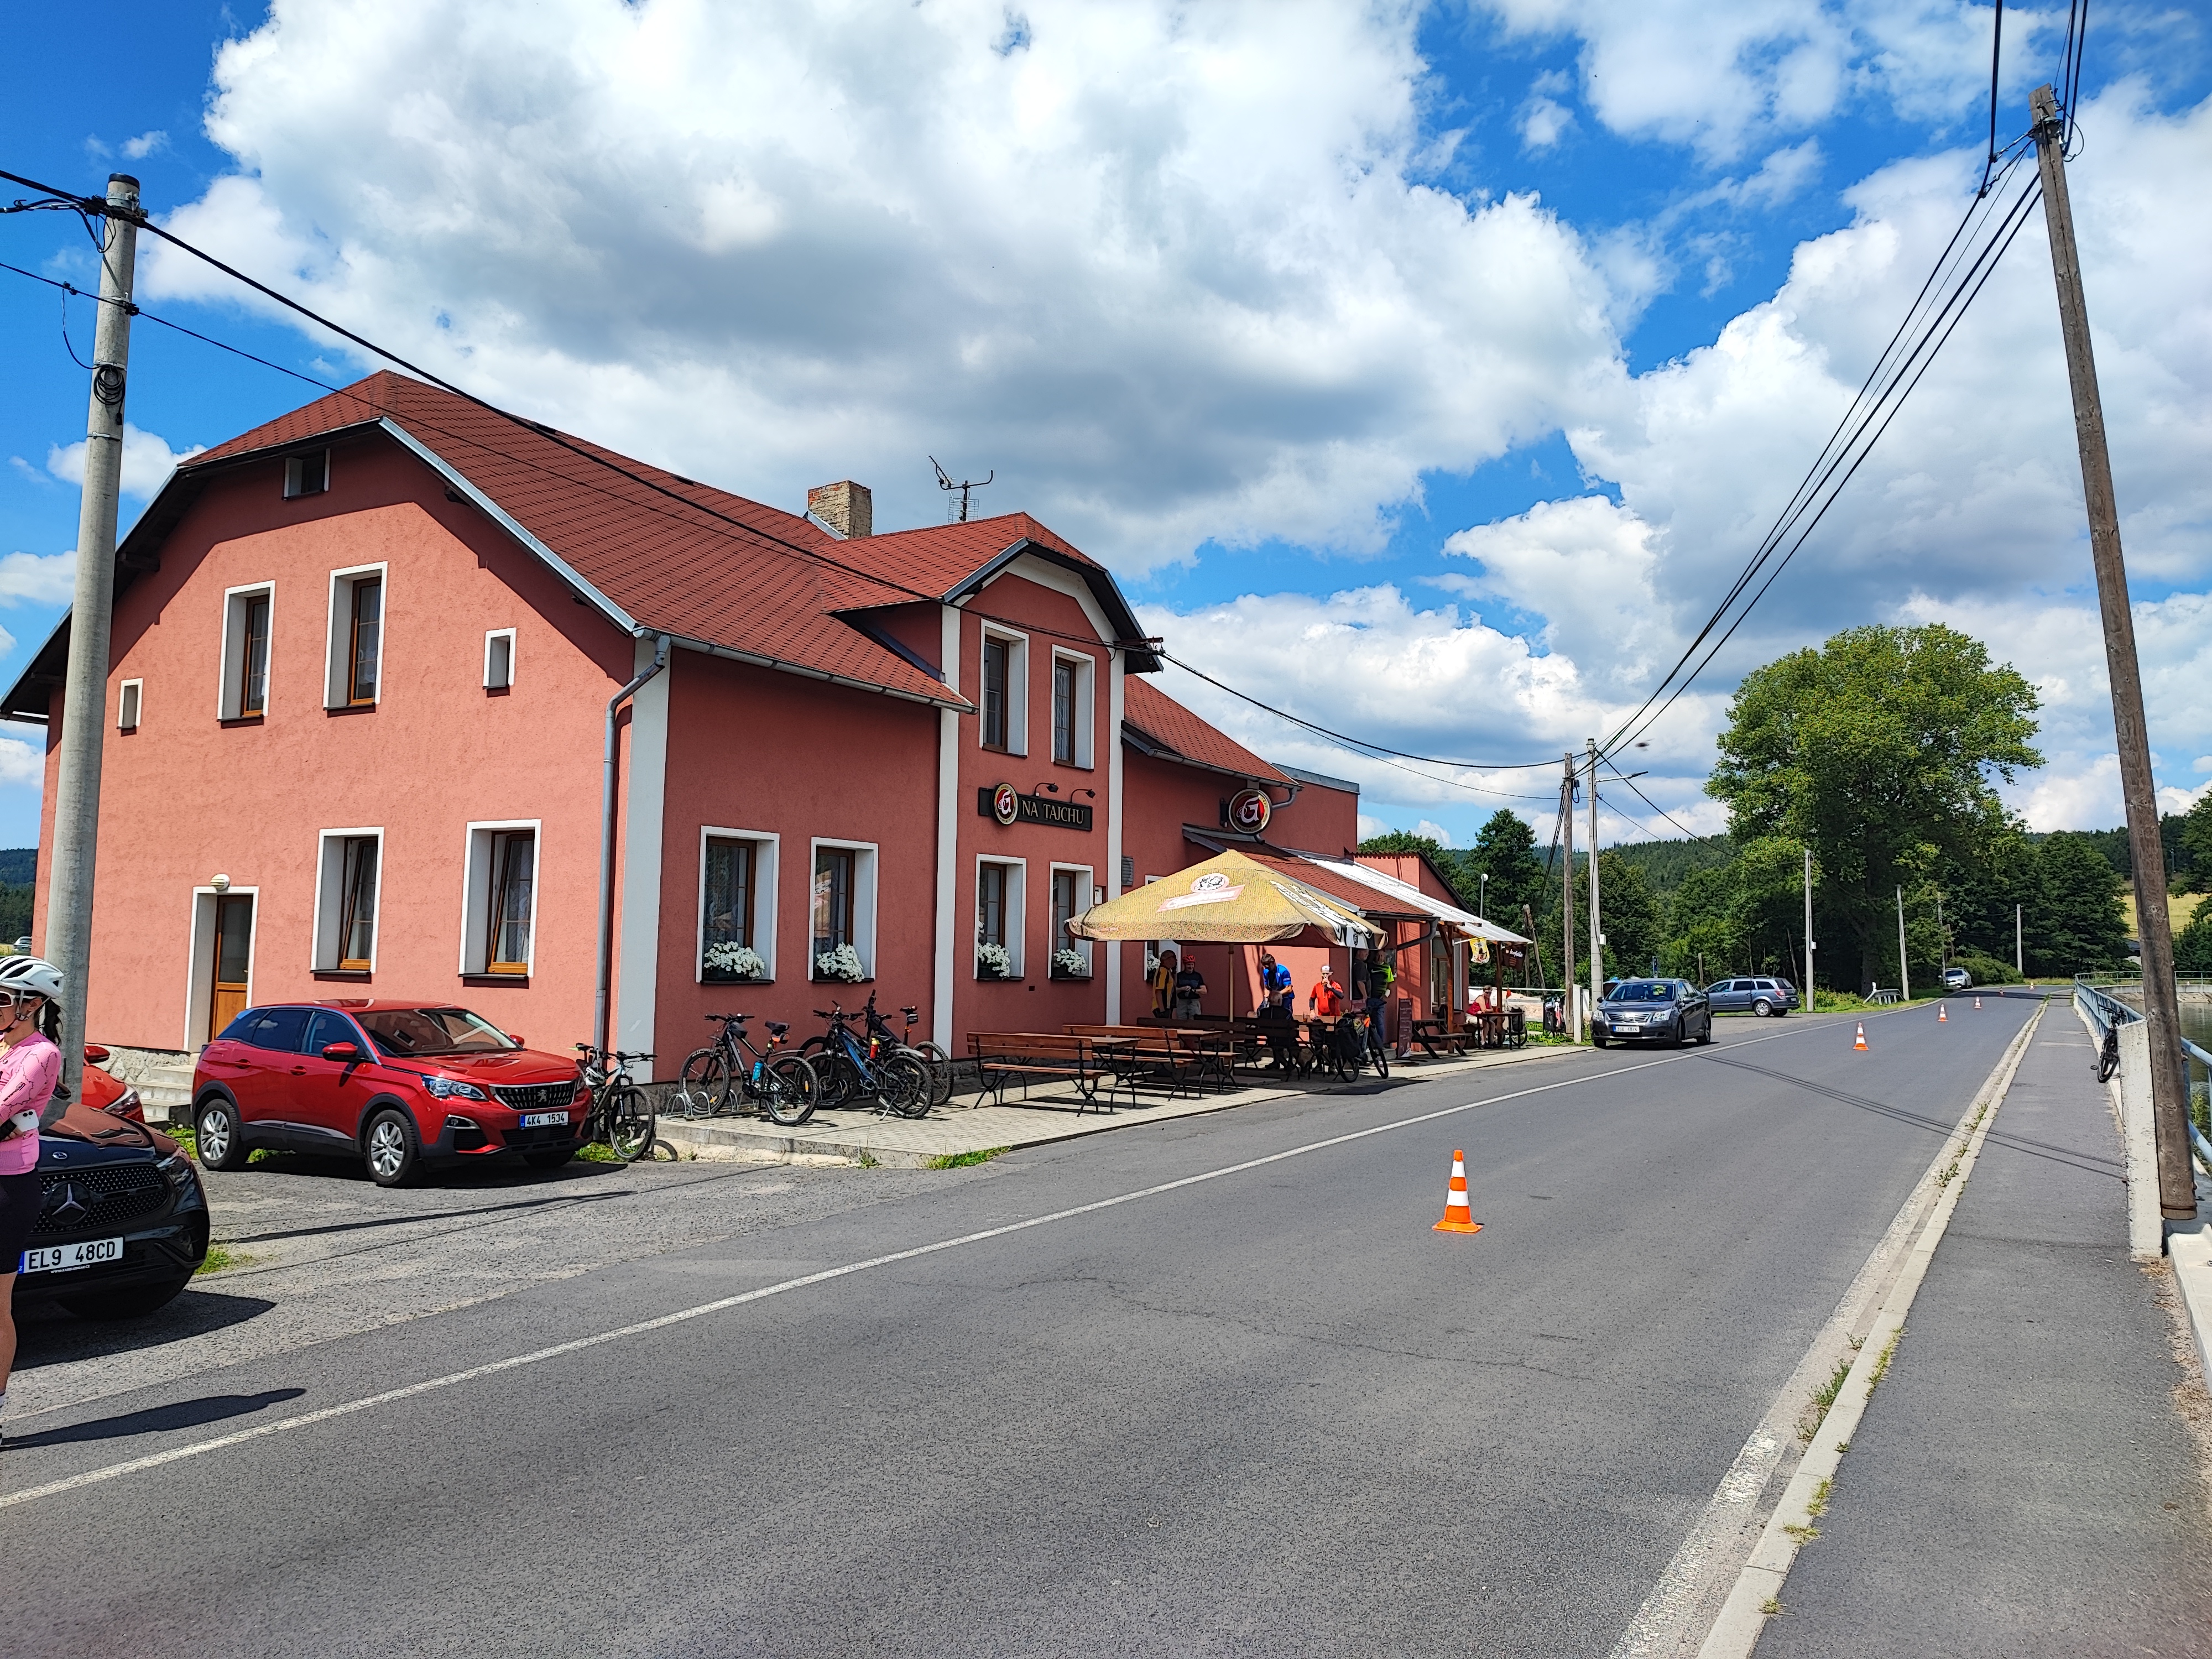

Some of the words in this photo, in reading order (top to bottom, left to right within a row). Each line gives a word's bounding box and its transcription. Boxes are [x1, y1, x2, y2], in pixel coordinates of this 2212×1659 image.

[1021, 800, 1039, 817] NA
[1043, 804, 1084, 825] TAJCHU
[526, 1115, 541, 1125] 4K4
[29, 1249, 61, 1270] EL9
[75, 1241, 115, 1262] 48CD
